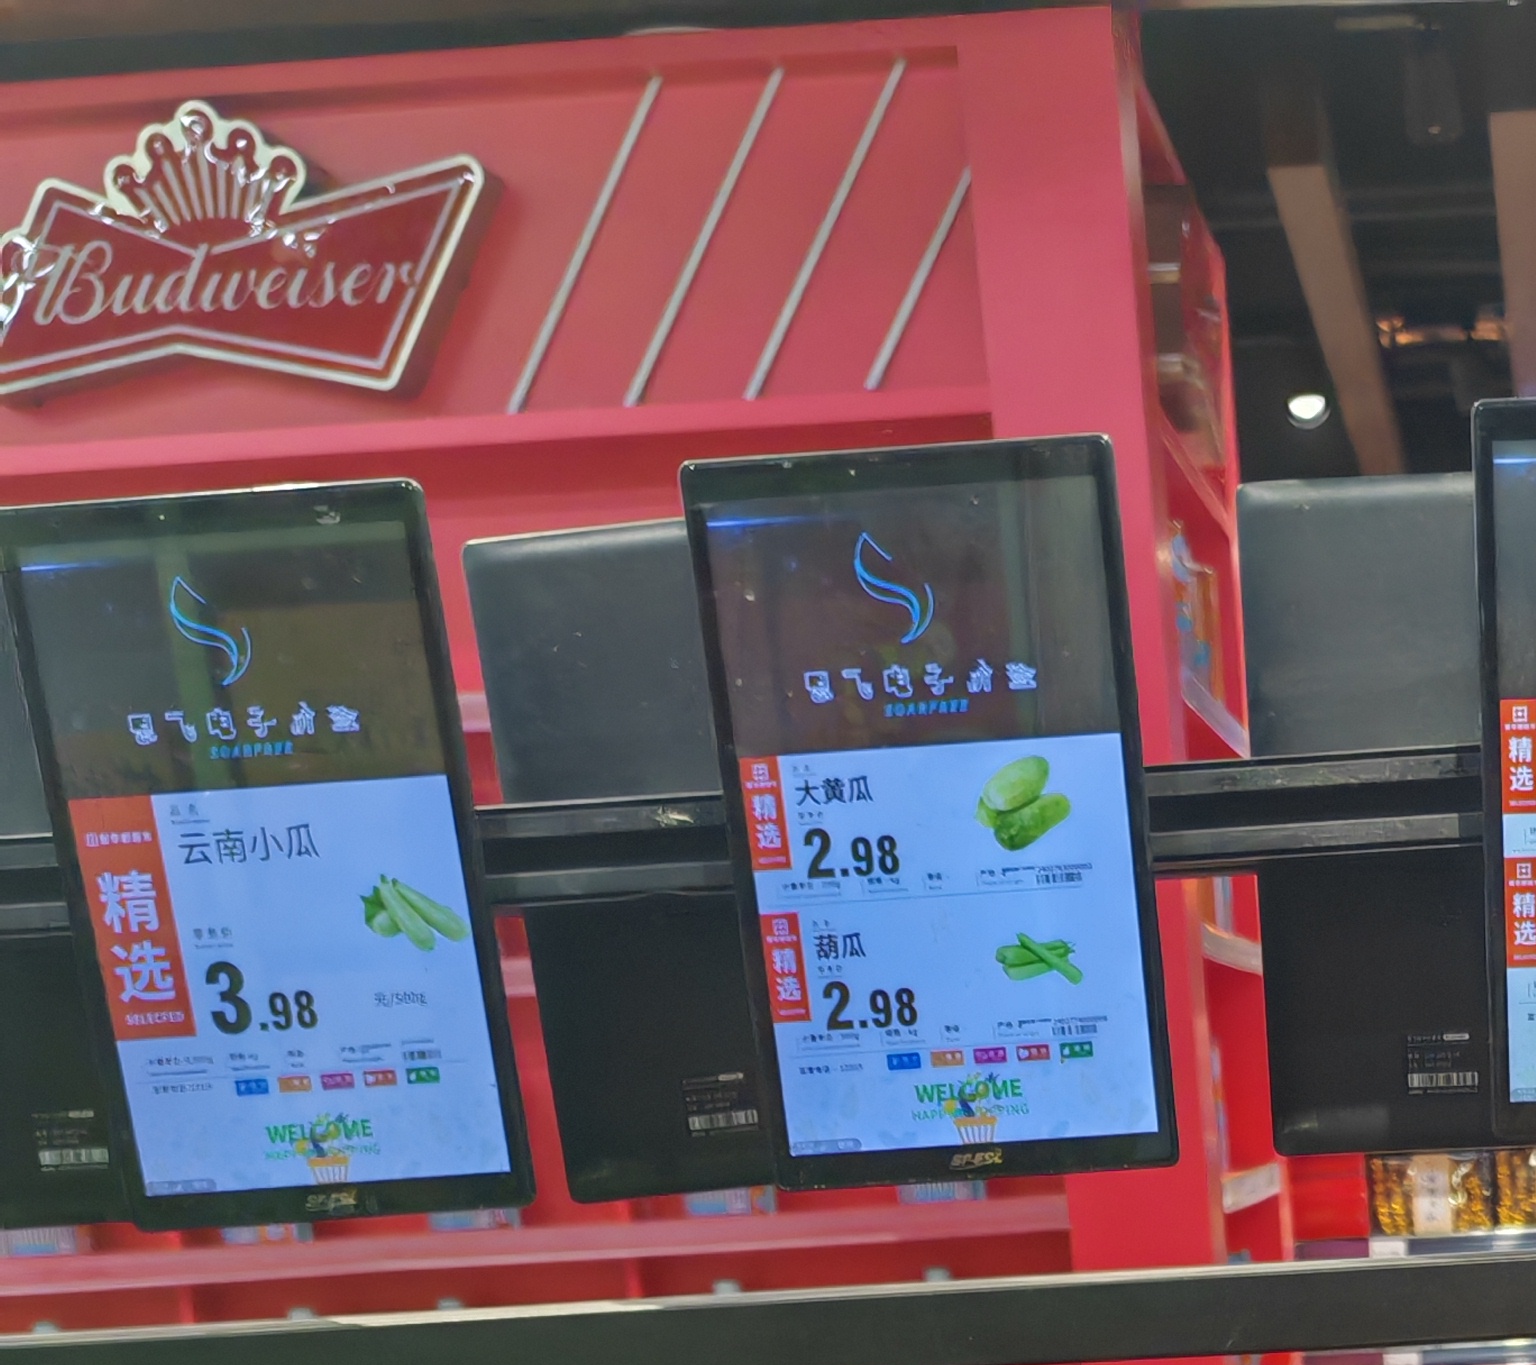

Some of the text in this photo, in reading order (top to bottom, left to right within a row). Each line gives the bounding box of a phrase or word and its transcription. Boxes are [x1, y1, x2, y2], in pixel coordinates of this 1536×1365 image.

[32, 239, 418, 325] Budweiser
[1508, 736, 1534, 792] 精选
[795, 775, 874, 807] 大黄瓜
[177, 823, 320, 865] 云南小瓜
[752, 793, 782, 850] 精选
[803, 827, 900, 880] 2.98
[97, 869, 176, 1002] 精选
[205, 960, 319, 1035] 3.98
[772, 948, 802, 1002] 精选
[822, 980, 918, 1031] 2.98
[914, 1078, 1023, 1104] WELCOME
[265, 1119, 373, 1143] WELCOME
